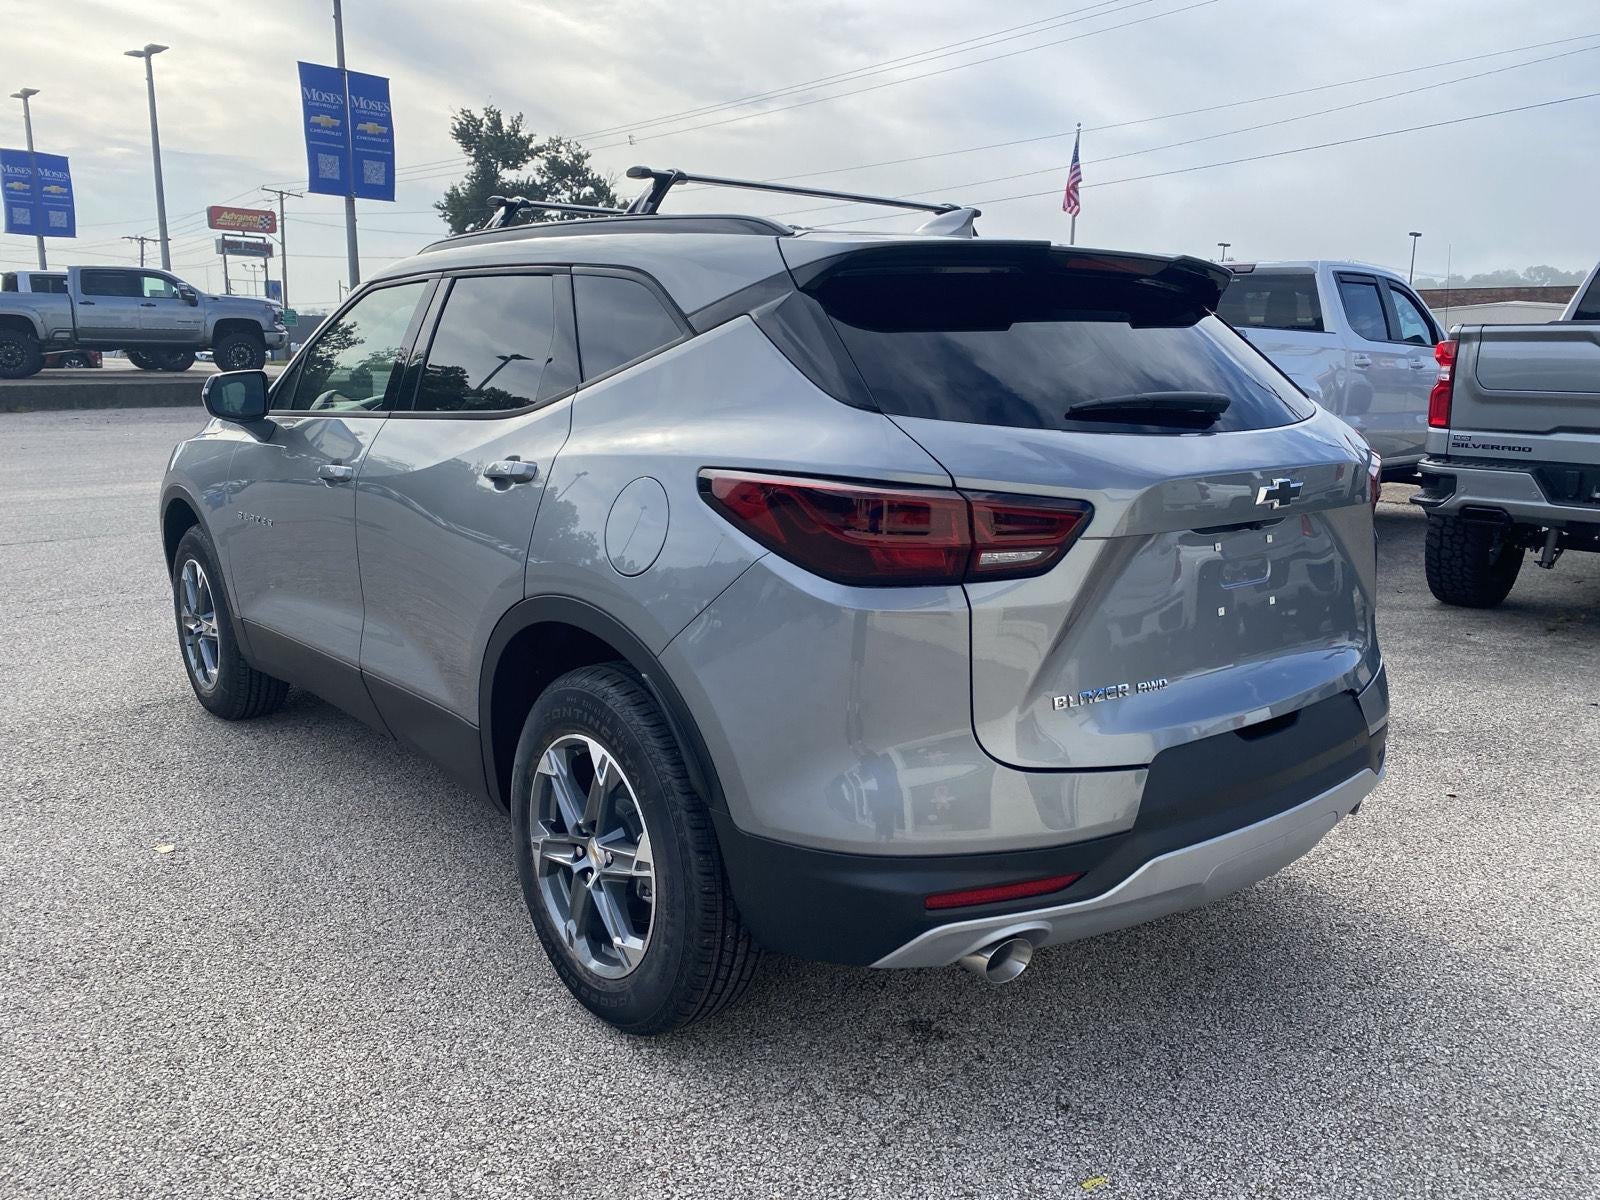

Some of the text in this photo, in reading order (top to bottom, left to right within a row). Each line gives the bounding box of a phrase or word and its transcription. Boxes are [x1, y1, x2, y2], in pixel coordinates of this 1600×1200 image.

[302, 87, 343, 105] MOSES
[350, 95, 391, 112] MOSES
[356, 135, 389, 143] CHEVROLET
[0, 164, 31, 175] MOSES
[37, 168, 70, 178] MOSES
[220, 211, 258, 223] Advance
[1452, 442, 1532, 452] SILVERADO
[1052, 678, 1169, 711] BLAZER AWD
